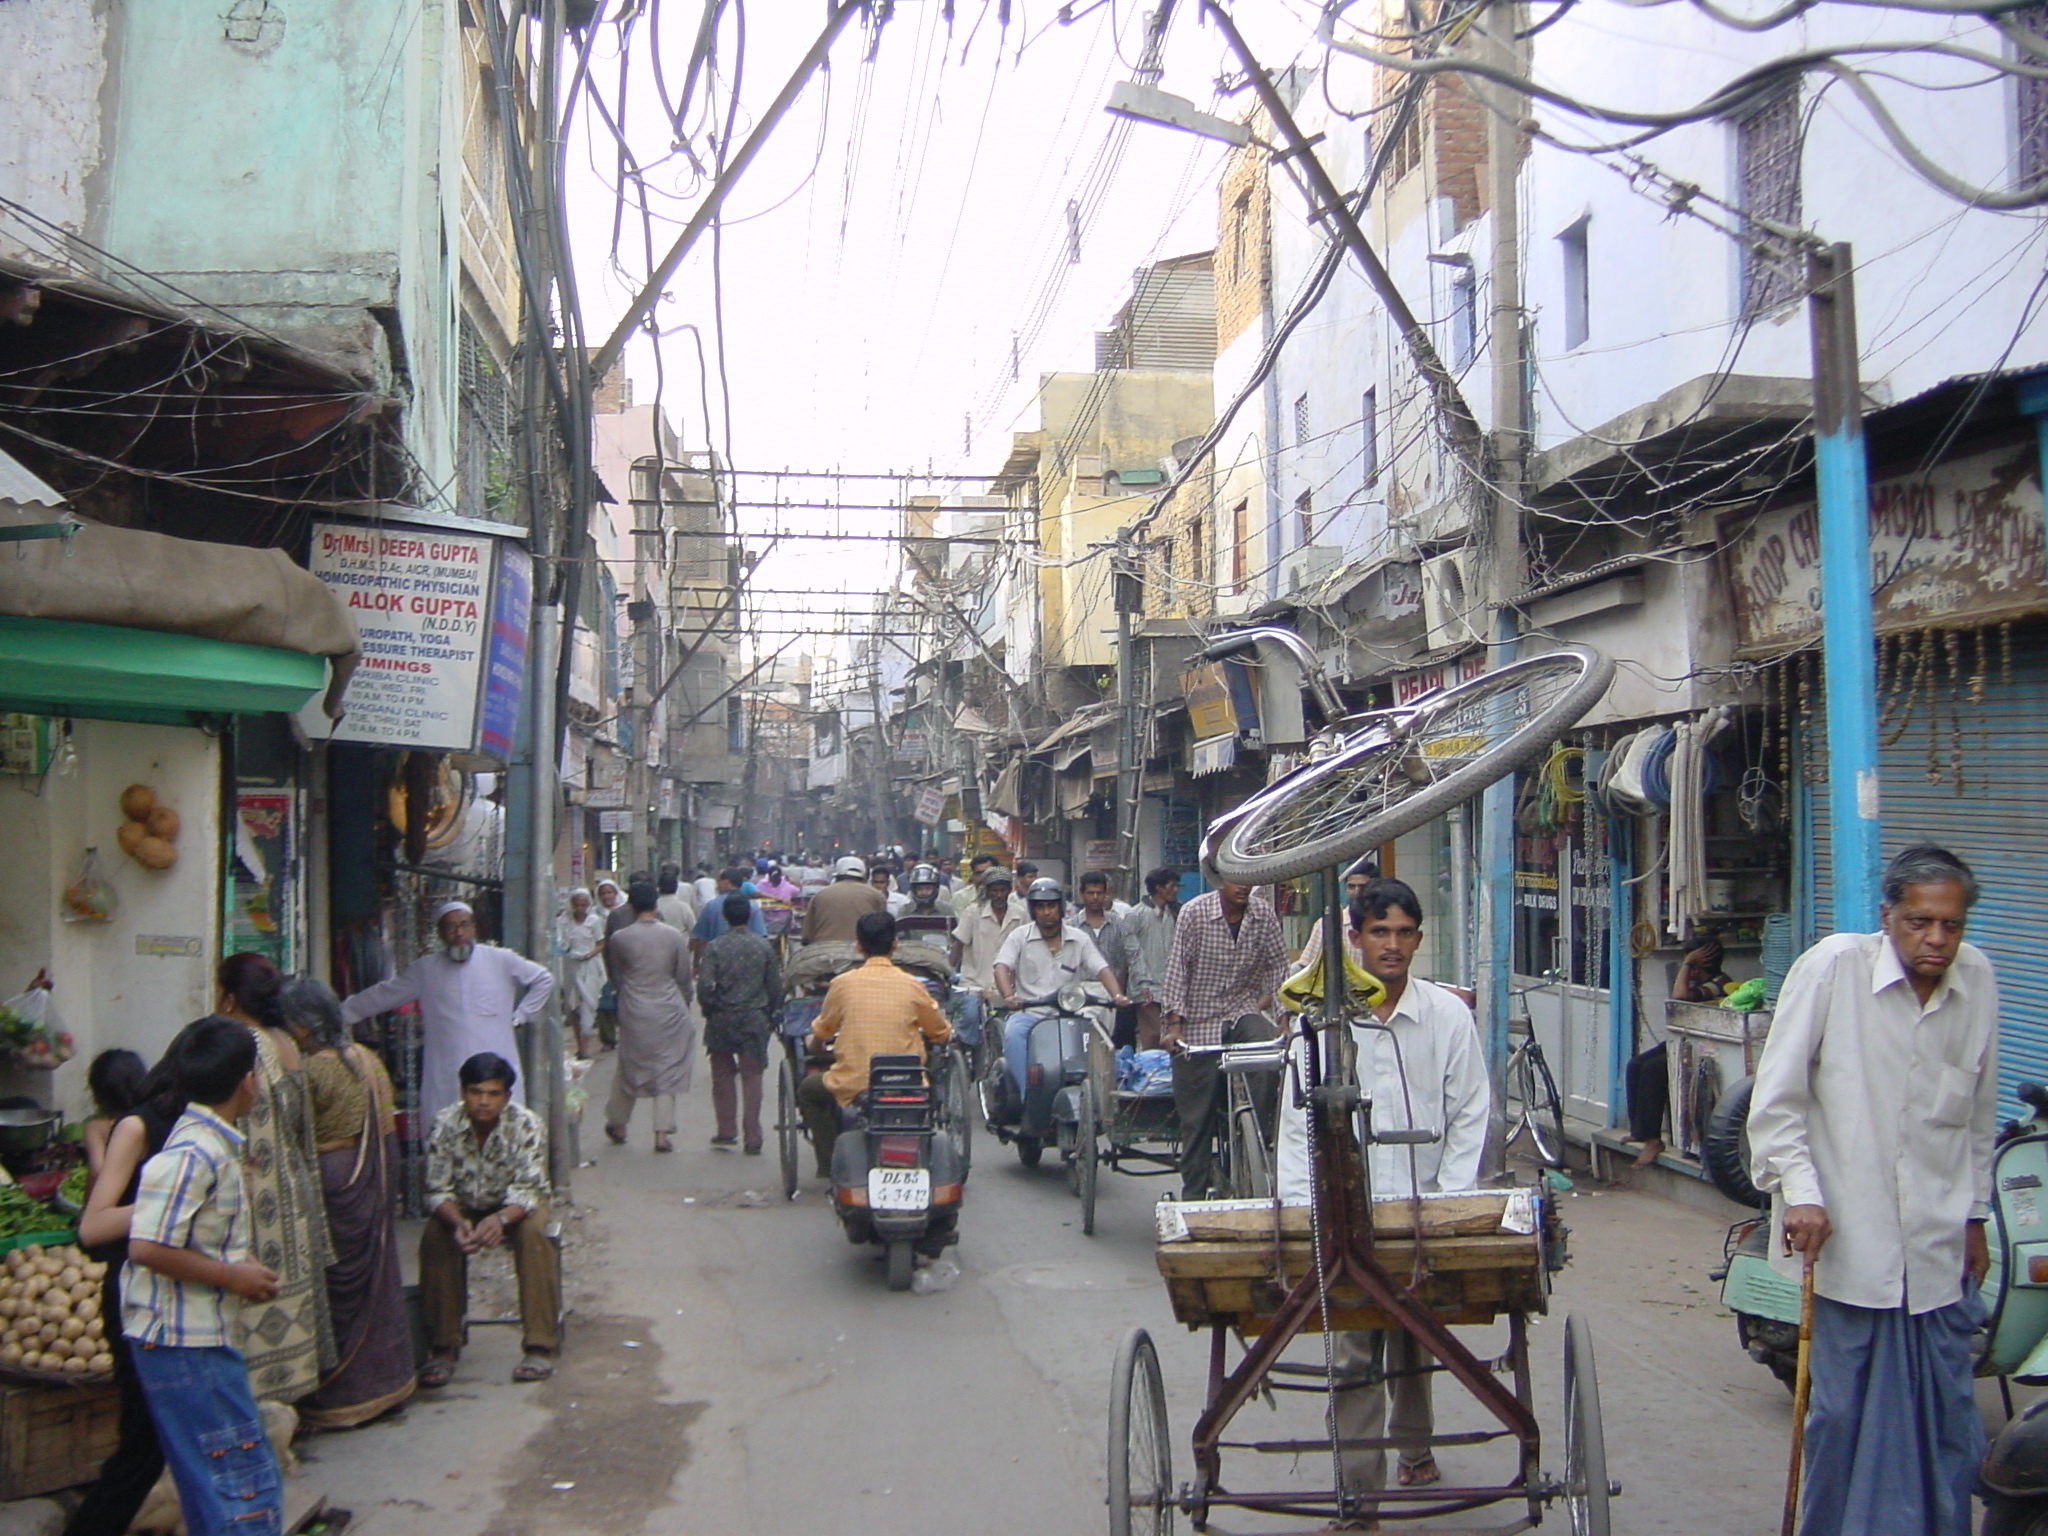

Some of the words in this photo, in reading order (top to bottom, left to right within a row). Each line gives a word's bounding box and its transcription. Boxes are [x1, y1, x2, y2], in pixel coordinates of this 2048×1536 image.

[380, 537, 425, 560] DEEPA
[430, 543, 479, 564] GUPTA
[433, 566, 478, 581] (MUMBAI)
[314, 570, 410, 590] HOMOEOPATHIC
[413, 581, 480, 597] PHYSICIAN
[348, 591, 404, 613] ALOK
[410, 597, 478, 619] GUPTA
[359, 628, 416, 645] UROPATH,
[419, 632, 451, 646] YOGA
[362, 642, 407, 656] ESSURE
[411, 645, 474, 661] THERAPIST
[352, 670, 392, 682] ARIBA
[396, 673, 439, 687] CLINIC
[341, 701, 402, 716] RYAGANJ
[404, 707, 448, 721] CLINIC
